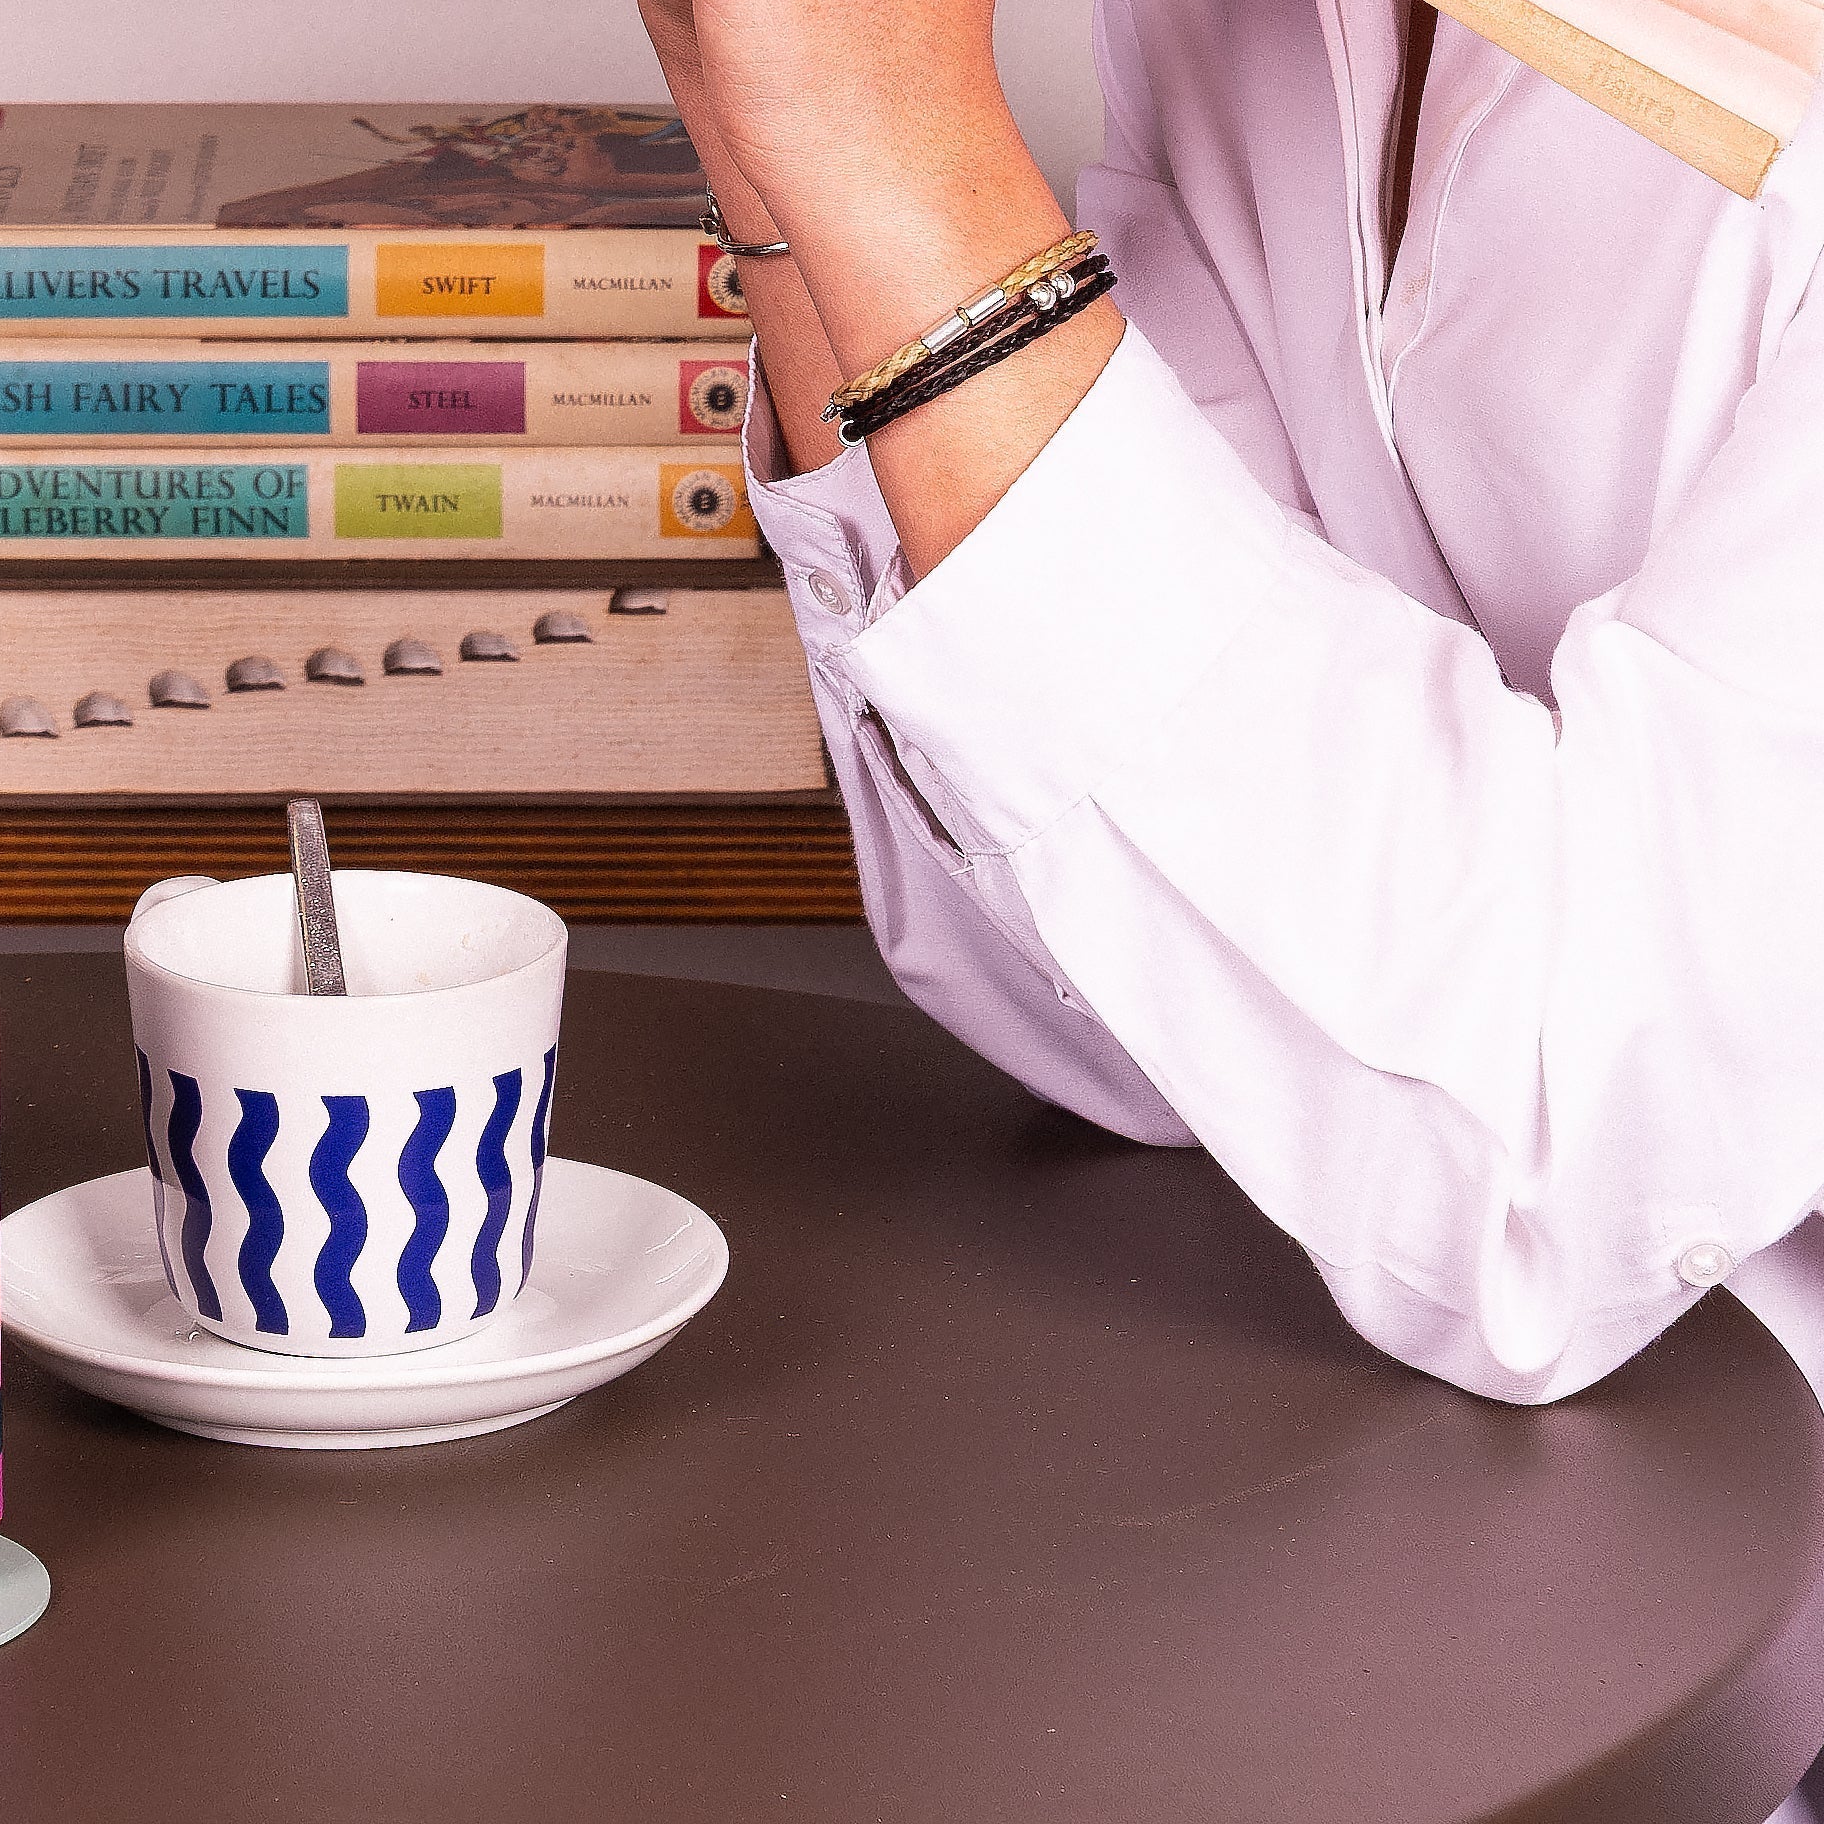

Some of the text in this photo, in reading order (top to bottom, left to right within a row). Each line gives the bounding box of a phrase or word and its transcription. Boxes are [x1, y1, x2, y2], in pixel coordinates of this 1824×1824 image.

[152, 268, 321, 301] TRAVELS
[422, 275, 497, 296] SWIFT
[573, 276, 674, 292] MACMILLAN
[71, 381, 191, 414] FAIRY
[209, 381, 328, 415] TALES
[406, 389, 477, 411] STEEL
[551, 391, 653, 408] MACMILLAN
[252, 468, 306, 501] OF
[376, 492, 461, 514] TWAIN
[529, 492, 630, 509] MACMILLAN
[190, 505, 292, 538] FINN
